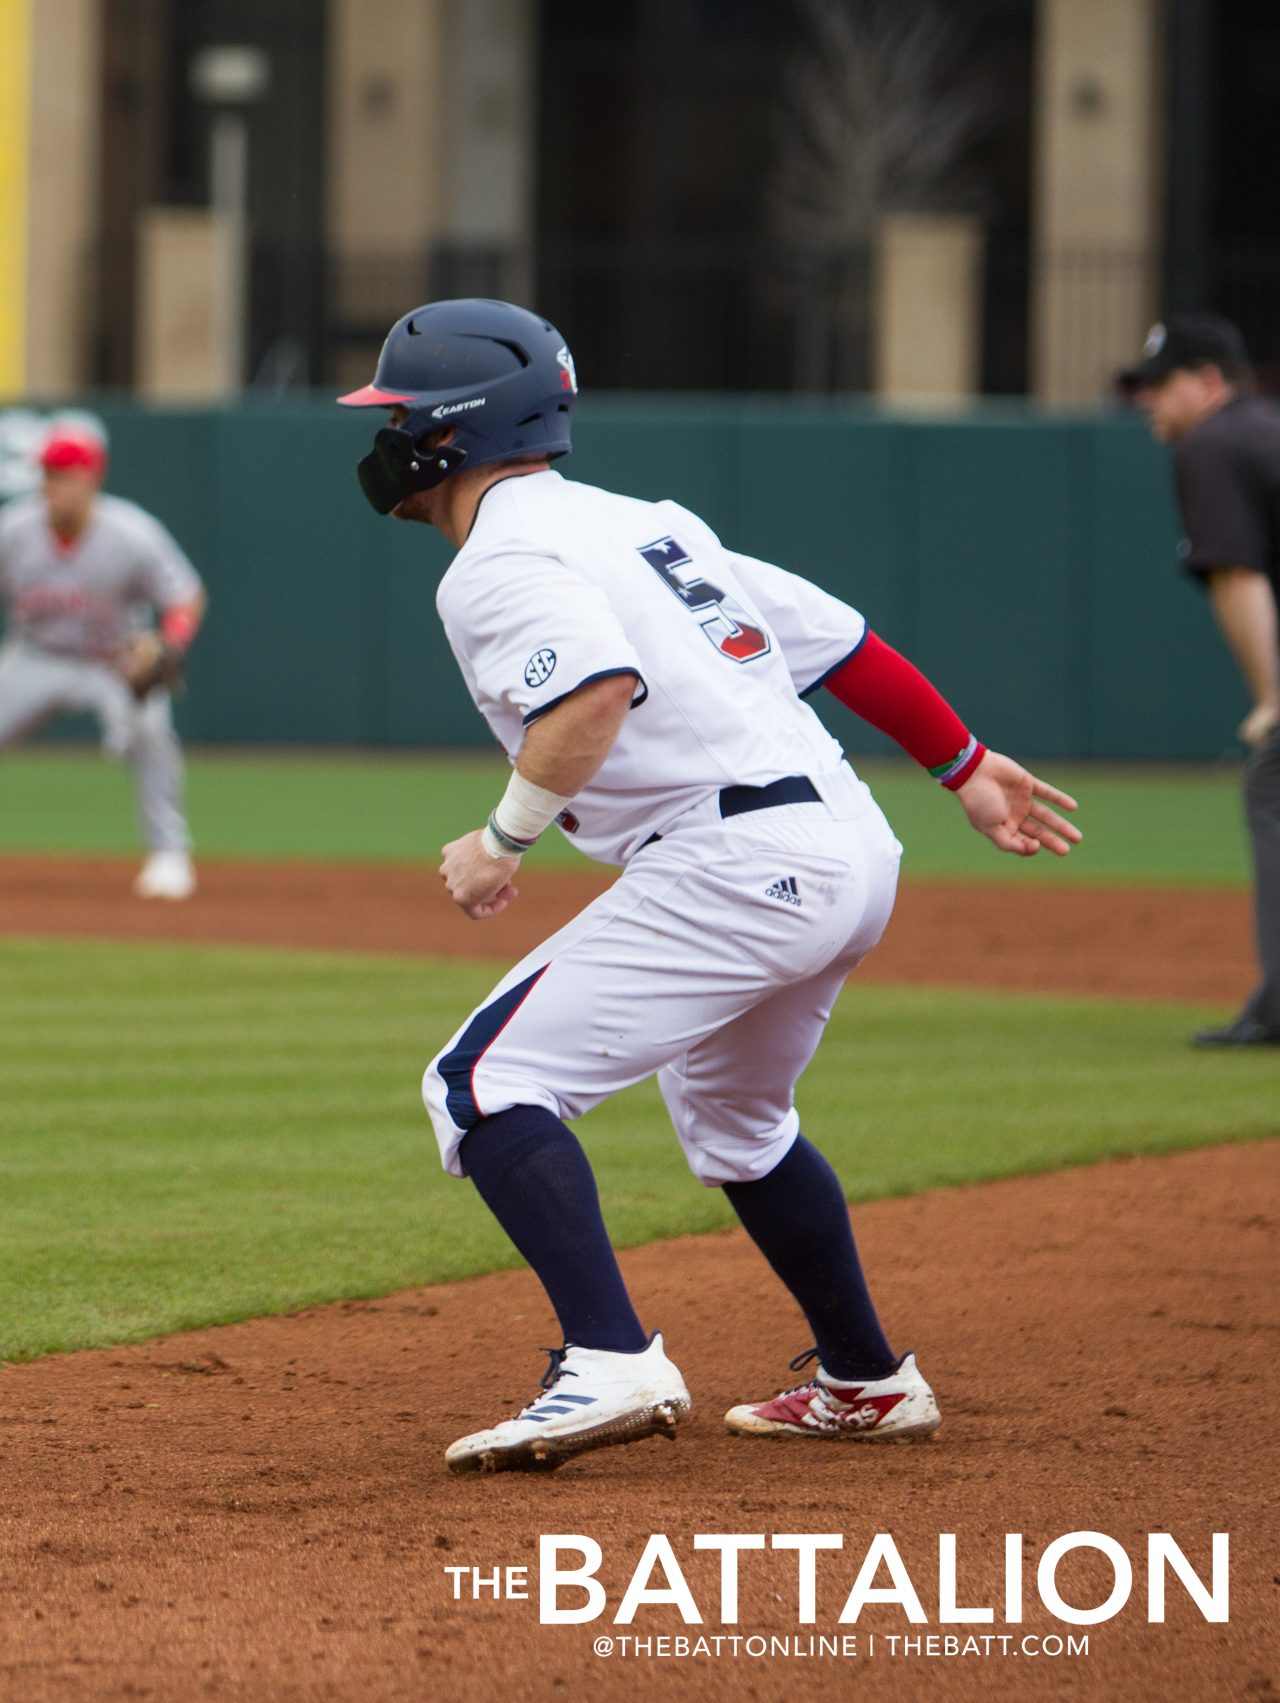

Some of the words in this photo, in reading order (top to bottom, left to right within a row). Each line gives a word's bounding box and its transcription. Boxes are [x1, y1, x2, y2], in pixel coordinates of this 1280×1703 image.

[442, 397, 486, 418] EASTON
[636, 535, 771, 664] 5
[525, 649, 556, 687] SEC
[765, 888, 802, 907] adidas
